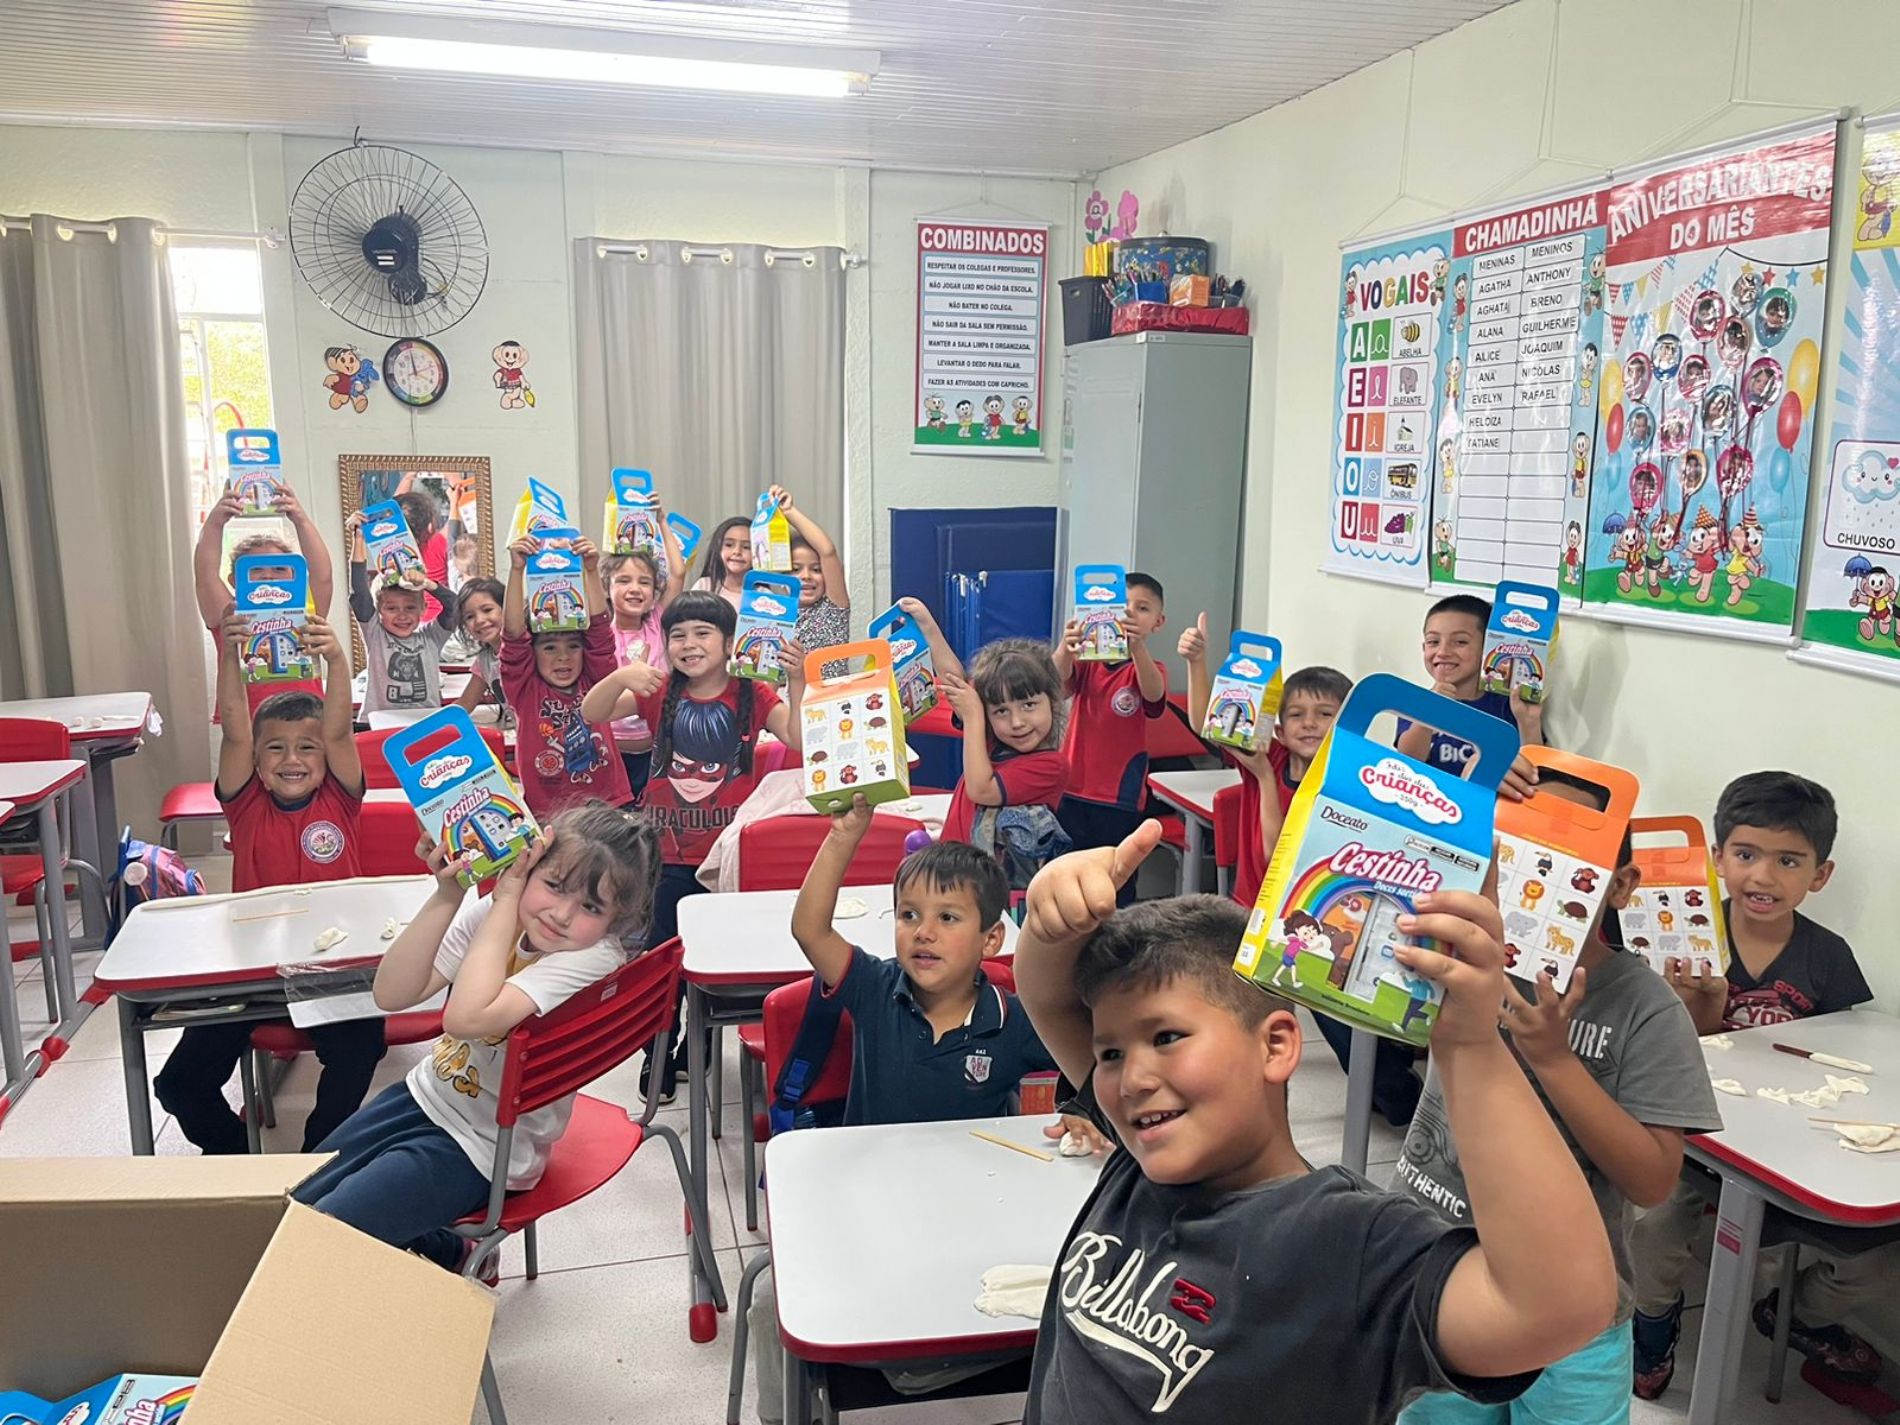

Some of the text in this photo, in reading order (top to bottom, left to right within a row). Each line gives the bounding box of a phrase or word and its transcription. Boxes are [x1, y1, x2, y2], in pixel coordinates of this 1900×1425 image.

[1607, 161, 1832, 245] ANIVERSARIANTES
[1465, 197, 1598, 252] CHAMADINHA
[1670, 205, 1755, 250] DO MÊS
[921, 227, 1044, 254] COMBINADOS
[1532, 242, 1573, 257] MENINOS
[927, 262, 957, 270] RESPEITAR
[966, 264, 992, 272] COLEGAS
[1479, 255, 1515, 271] MENINAS
[1526, 267, 1572, 284] ANTHONY
[929, 281, 940, 289] NÃO
[942, 282, 960, 290] JOGAR
[986, 284, 1001, 292] CHÃO
[1360, 271, 1429, 311] VOGAIS
[1479, 279, 1511, 294] AGATHA
[962, 302, 979, 310] BATER
[1531, 294, 1562, 308] BRENO
[932, 320, 944, 328] NÃO
[1522, 316, 1576, 334] GUILHERME
[1477, 326, 1504, 338] ALANA
[1352, 327, 1366, 359] A
[1522, 340, 1564, 355] JOAQUIM
[1400, 348, 1422, 357] ABELHA
[1475, 351, 1500, 362] ALICE
[1478, 372, 1495, 382] ANA
[1522, 364, 1560, 378] NICOLAS
[928, 378, 944, 386] FAZER
[1351, 372, 1364, 404] E
[1394, 396, 1422, 405] ELEFANTE
[1472, 393, 1502, 405] EVELYN
[1522, 389, 1556, 402] RAFAEL
[1469, 417, 1502, 428] HELOIZA
[1352, 417, 1358, 448] I
[1394, 444, 1414, 452] IGREJA
[1468, 438, 1499, 448] TATIANE
[1346, 461, 1358, 492] O
[1390, 490, 1412, 500] ÔNIBUS
[1344, 506, 1356, 536] U
[1837, 532, 1896, 550] CHUVOSO
[250, 616, 292, 634] Cestinha
[1362, 767, 1457, 818] Crianças
[443, 786, 490, 828] Cestinha
[646, 803, 740, 830] IRACULOU
[1330, 842, 1442, 893] Cestinha
[1061, 1231, 1215, 1413] Billabong
